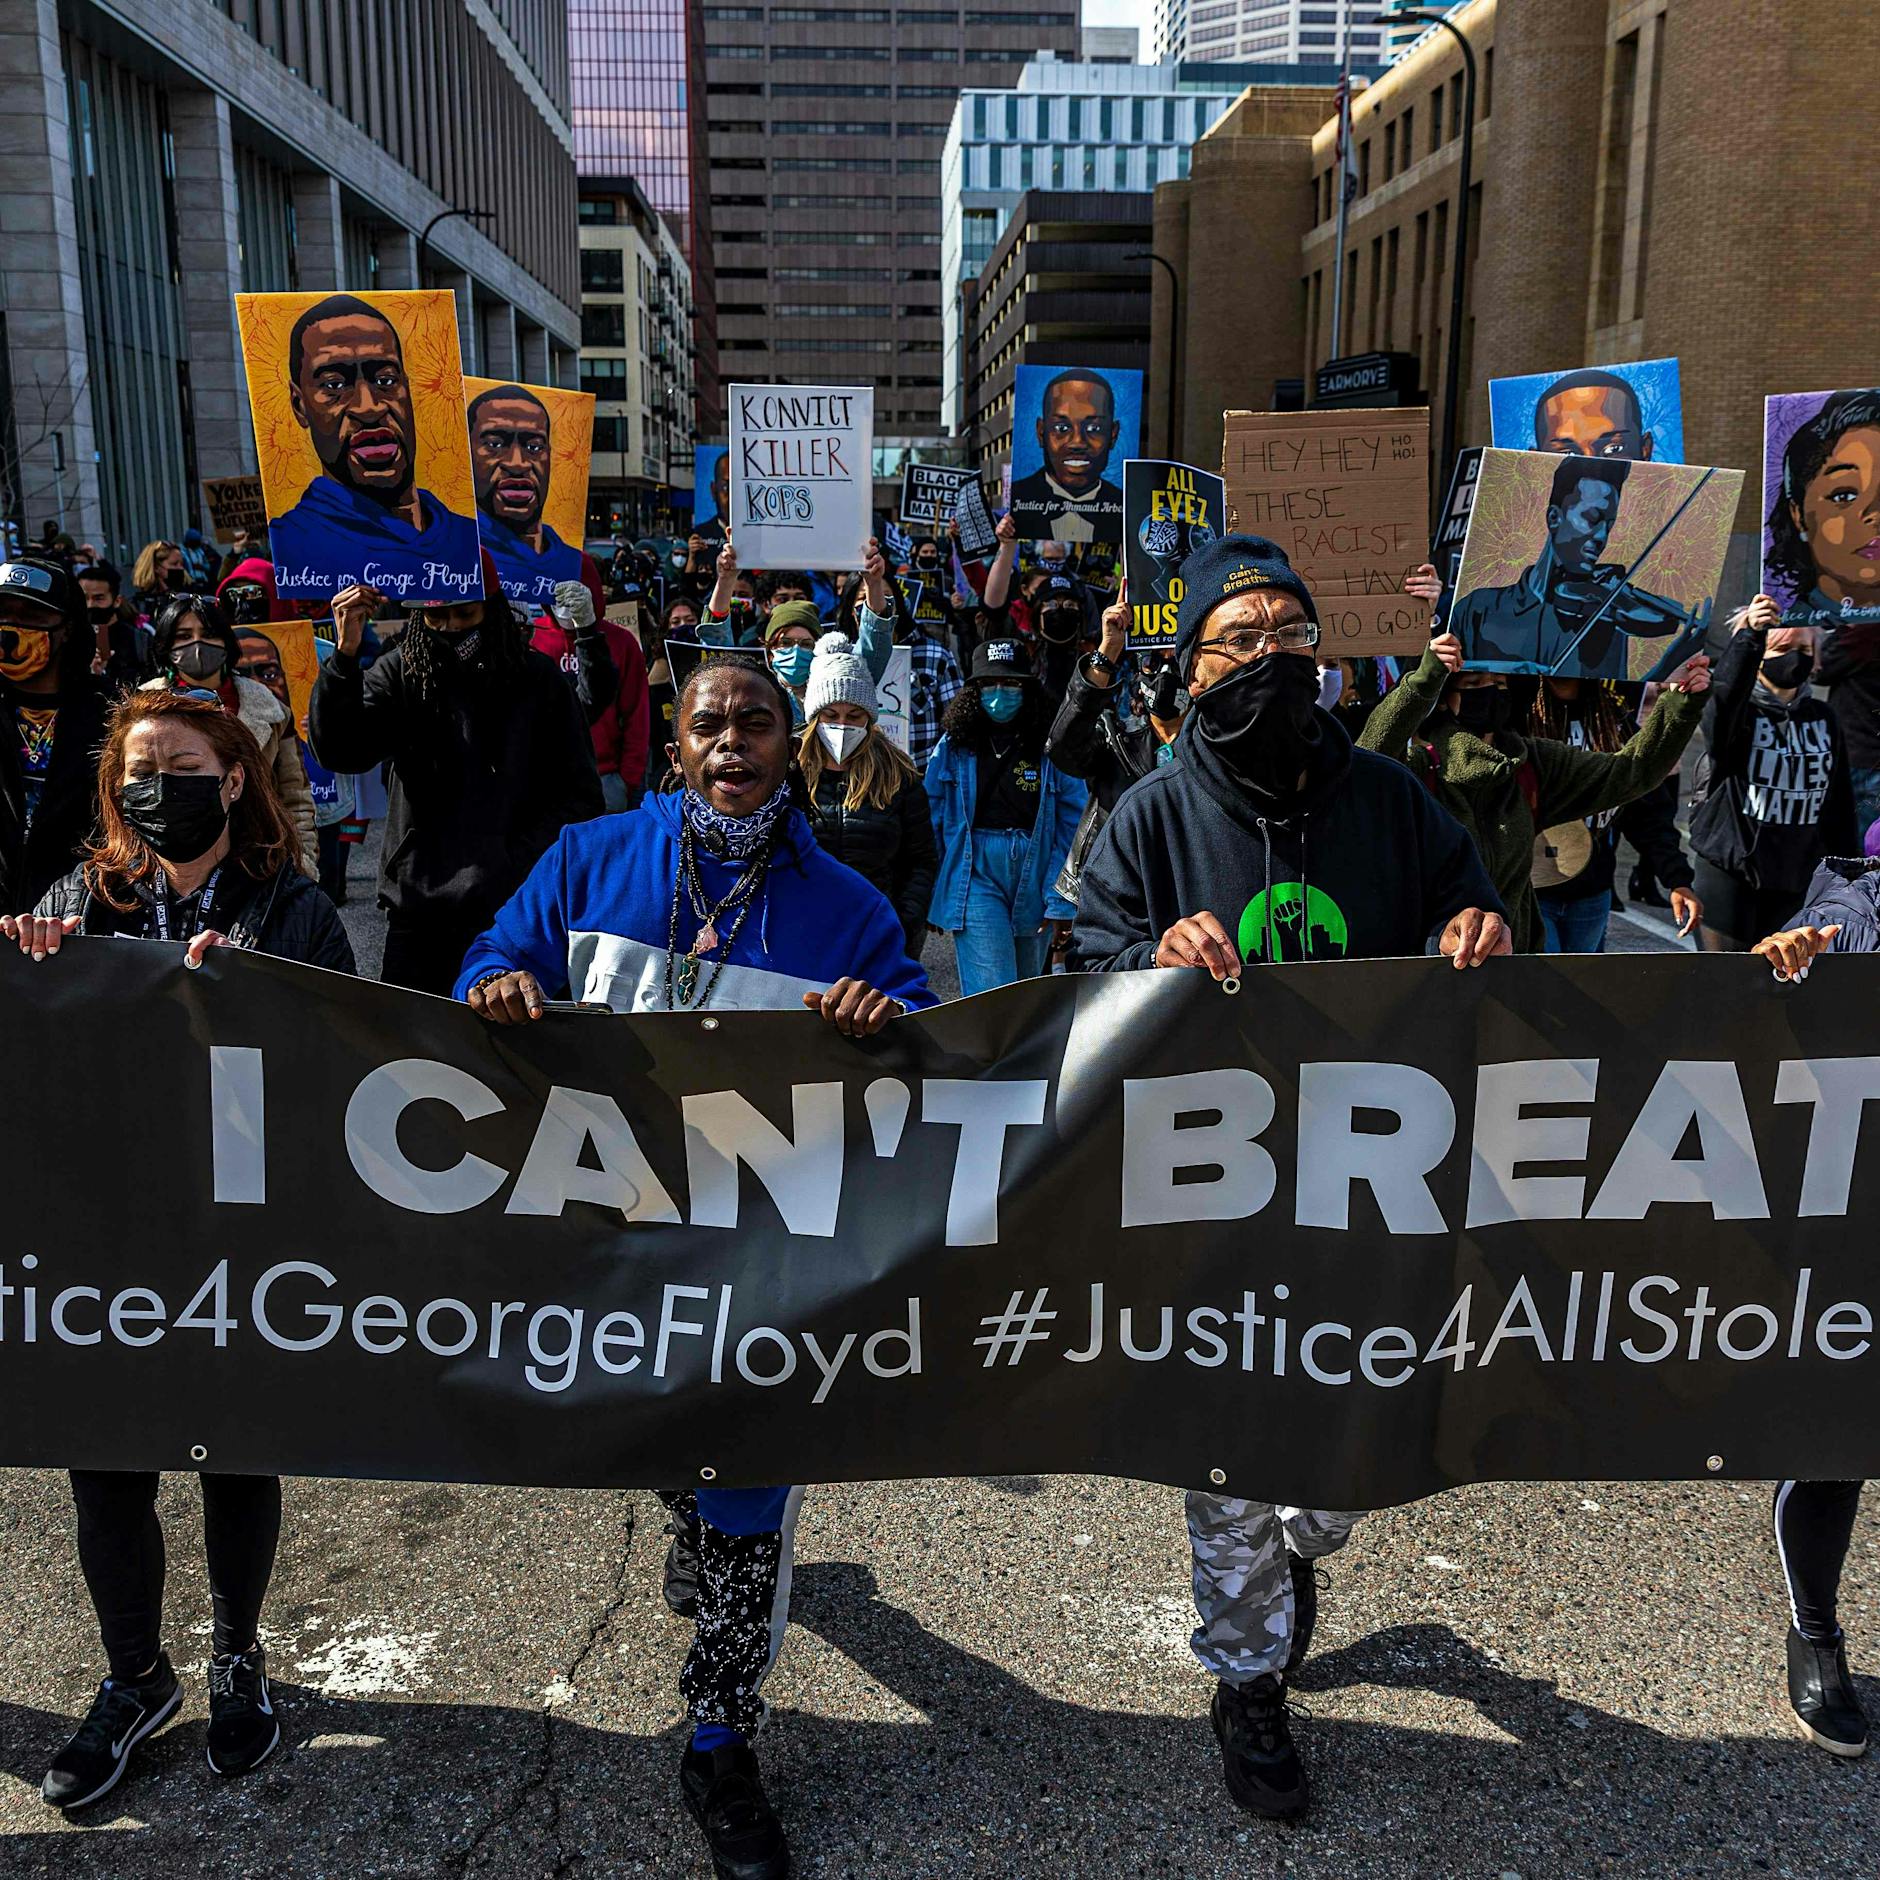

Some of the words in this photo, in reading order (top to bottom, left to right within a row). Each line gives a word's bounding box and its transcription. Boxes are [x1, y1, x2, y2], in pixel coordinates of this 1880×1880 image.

[1327, 368, 1378, 392] ARMORY
[741, 395, 853, 429] KONVICT
[742, 437, 849, 477] KILLER
[1320, 436, 1380, 472] HEY
[1392, 435, 1412, 446] HO
[1166, 466, 1197, 495] ALL
[745, 482, 813, 522] KOPS
[1013, 499, 1044, 512] Justice
[1042, 501, 1060, 515] for
[1060, 501, 1099, 513] Ahmaud
[1151, 489, 1209, 528] EYEZ
[1246, 487, 1345, 522] THESE
[1293, 523, 1412, 560] RACIST
[275, 565, 332, 588] Justice
[338, 572, 359, 591] for
[364, 562, 416, 595] George
[422, 562, 480, 595] Floyd
[1223, 574, 1270, 594] Breathe
[1229, 567, 1260, 581] Can't
[1130, 636, 1161, 645] JUSTICE
[1324, 611, 1362, 638] TO
[1377, 609, 1425, 636] GO!!
[1752, 717, 1831, 754] BLACK
[310, 779, 336, 800] loyd
[1742, 784, 1826, 825] MATTE
[210, 1045, 265, 1204] I
[345, 1058, 1048, 1247] CAN'T
[973, 1268, 1873, 1388] #Justice4AllStole
